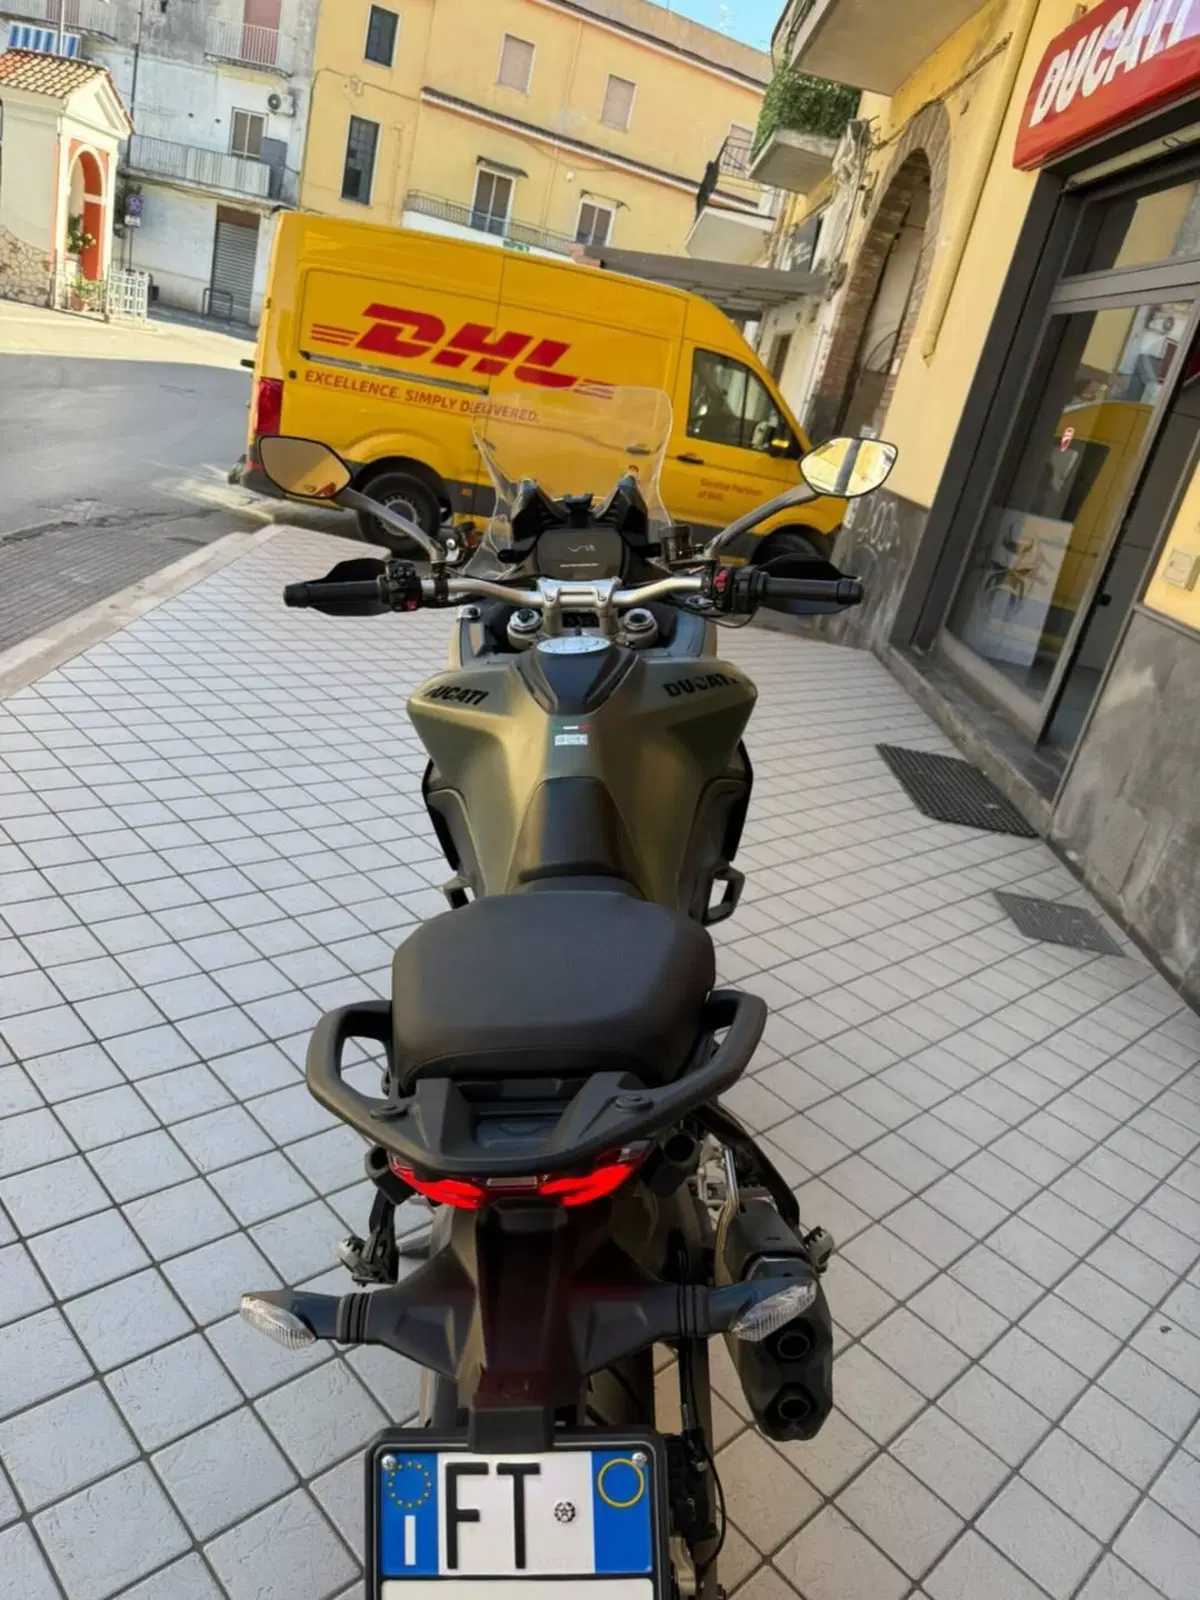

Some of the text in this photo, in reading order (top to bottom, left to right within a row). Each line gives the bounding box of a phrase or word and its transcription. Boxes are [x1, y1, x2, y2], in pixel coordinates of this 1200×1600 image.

[355, 302, 580, 388] DHL
[405, 389, 459, 411] SIMPLY
[445, 1461, 541, 1570] FT
